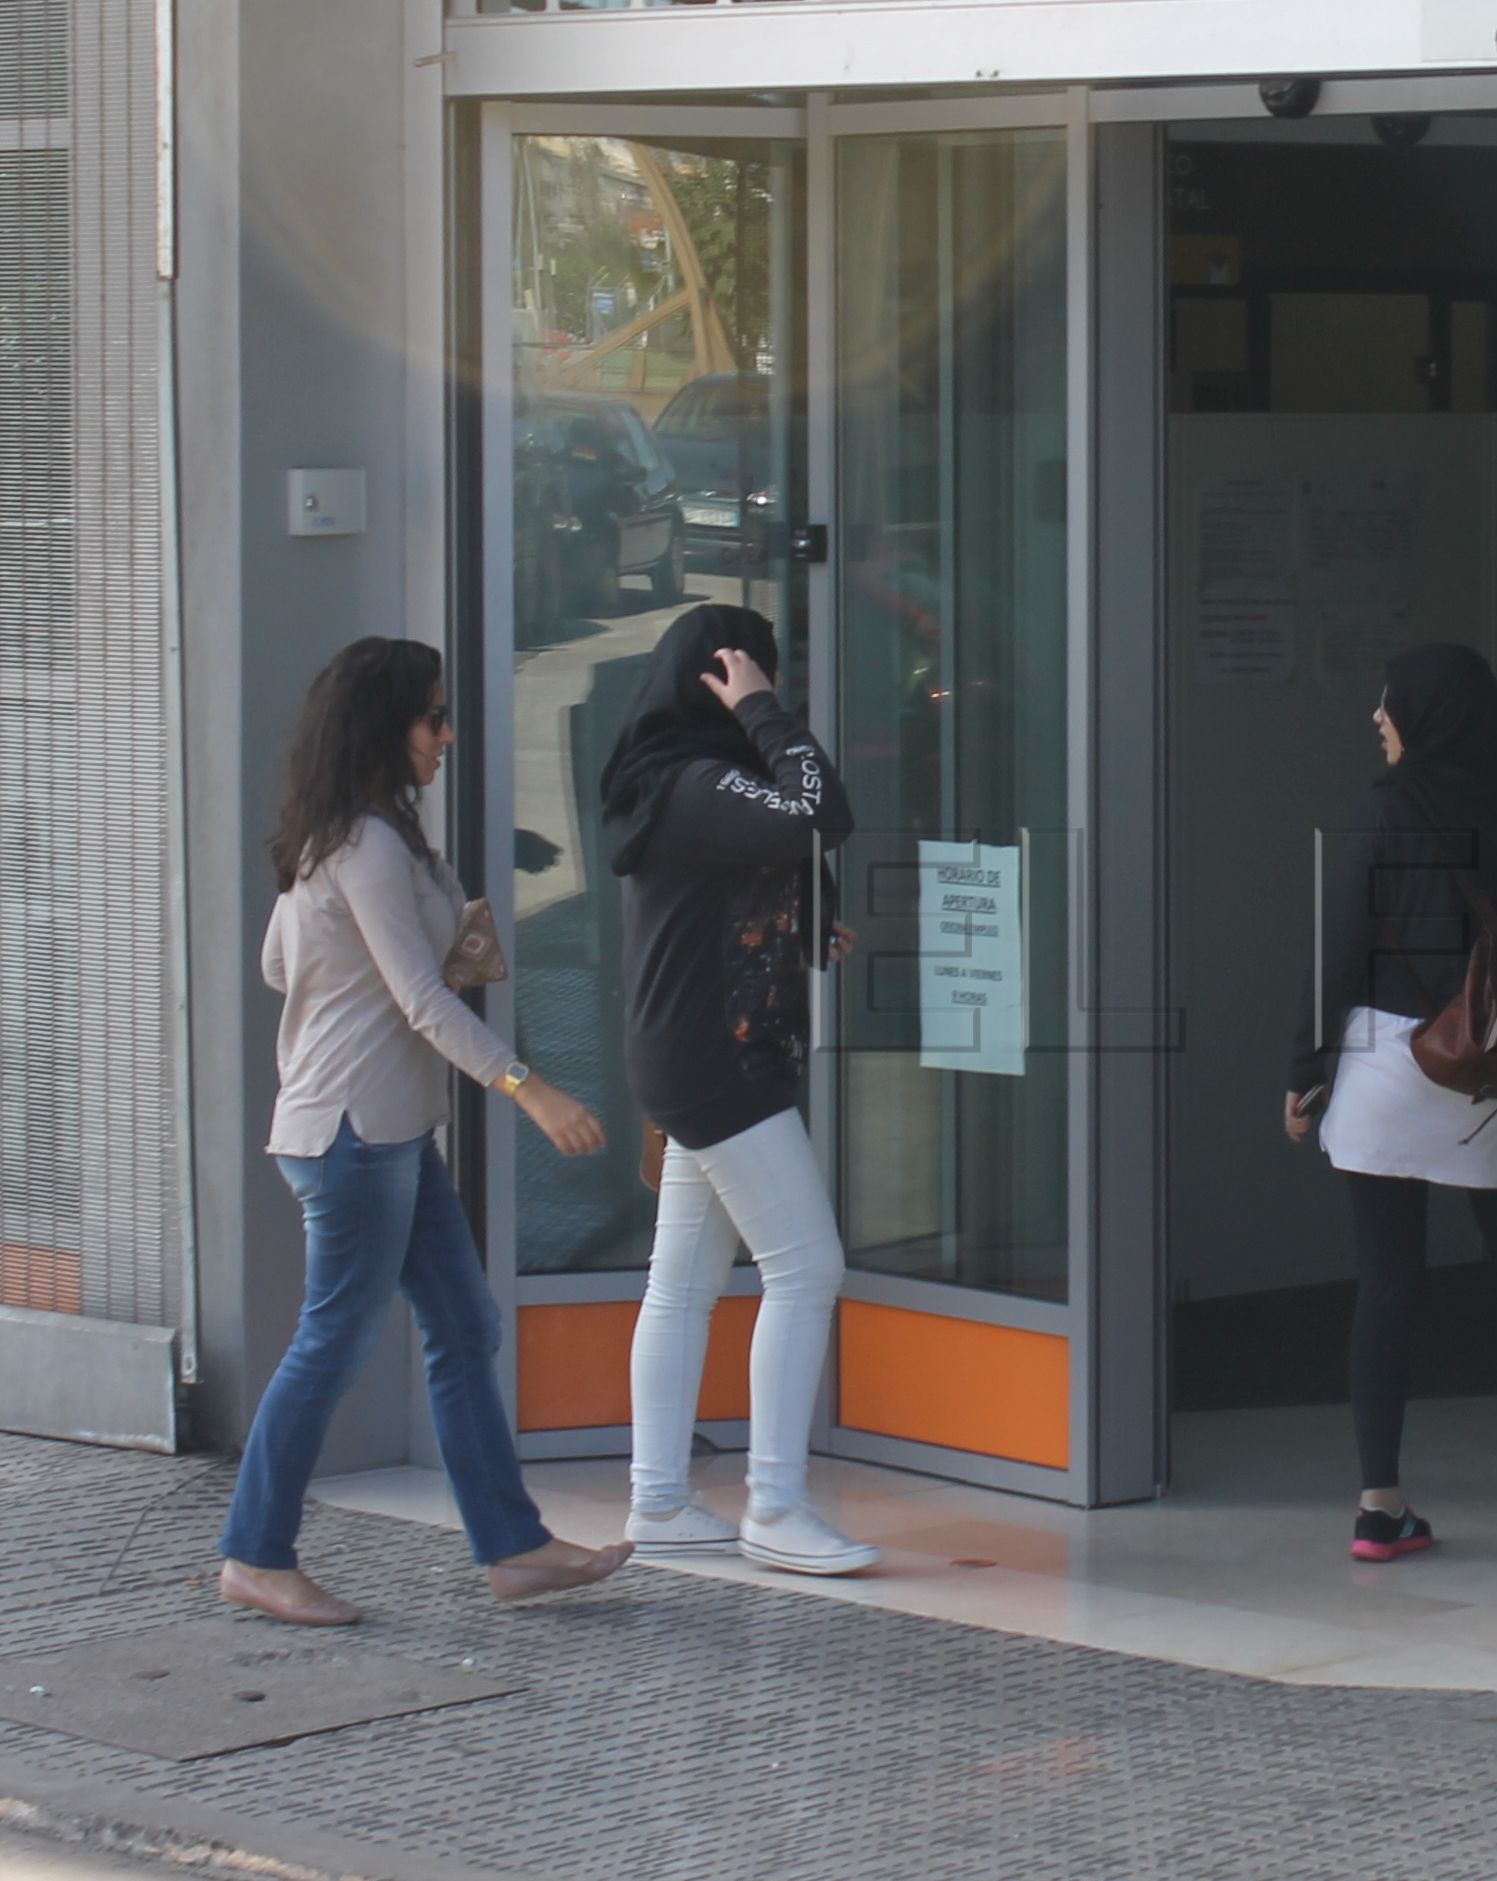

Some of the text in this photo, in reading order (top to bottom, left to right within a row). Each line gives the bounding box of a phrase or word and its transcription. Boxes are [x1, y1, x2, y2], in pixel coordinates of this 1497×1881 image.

[937, 866, 1001, 887] HORARIO DE
[942, 894, 996, 913] APERTURA
